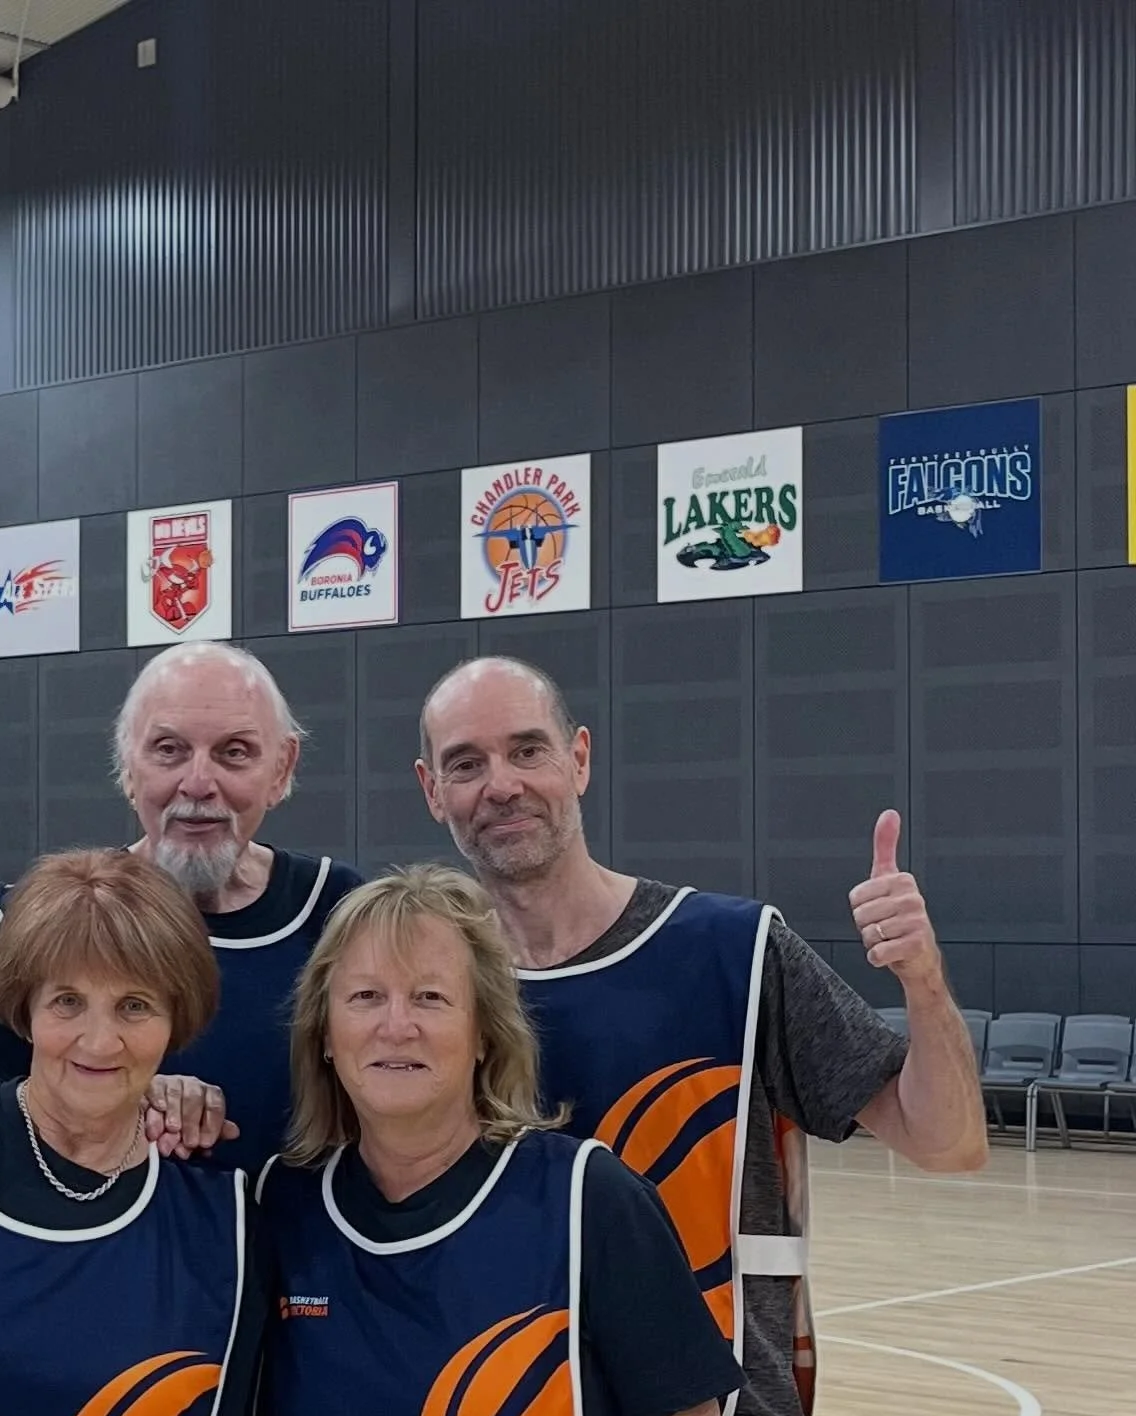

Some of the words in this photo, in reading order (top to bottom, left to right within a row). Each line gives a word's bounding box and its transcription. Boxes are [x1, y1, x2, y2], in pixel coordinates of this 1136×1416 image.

[471, 467, 544, 527] CHANDLER
[546, 473, 582, 518] PARK
[888, 451, 1032, 516] FALCONS
[663, 483, 797, 546] LAKERS
[300, 584, 371, 602] BUFFALOES
[310, 573, 353, 586] BORONIA
[484, 560, 562, 613] JETS
